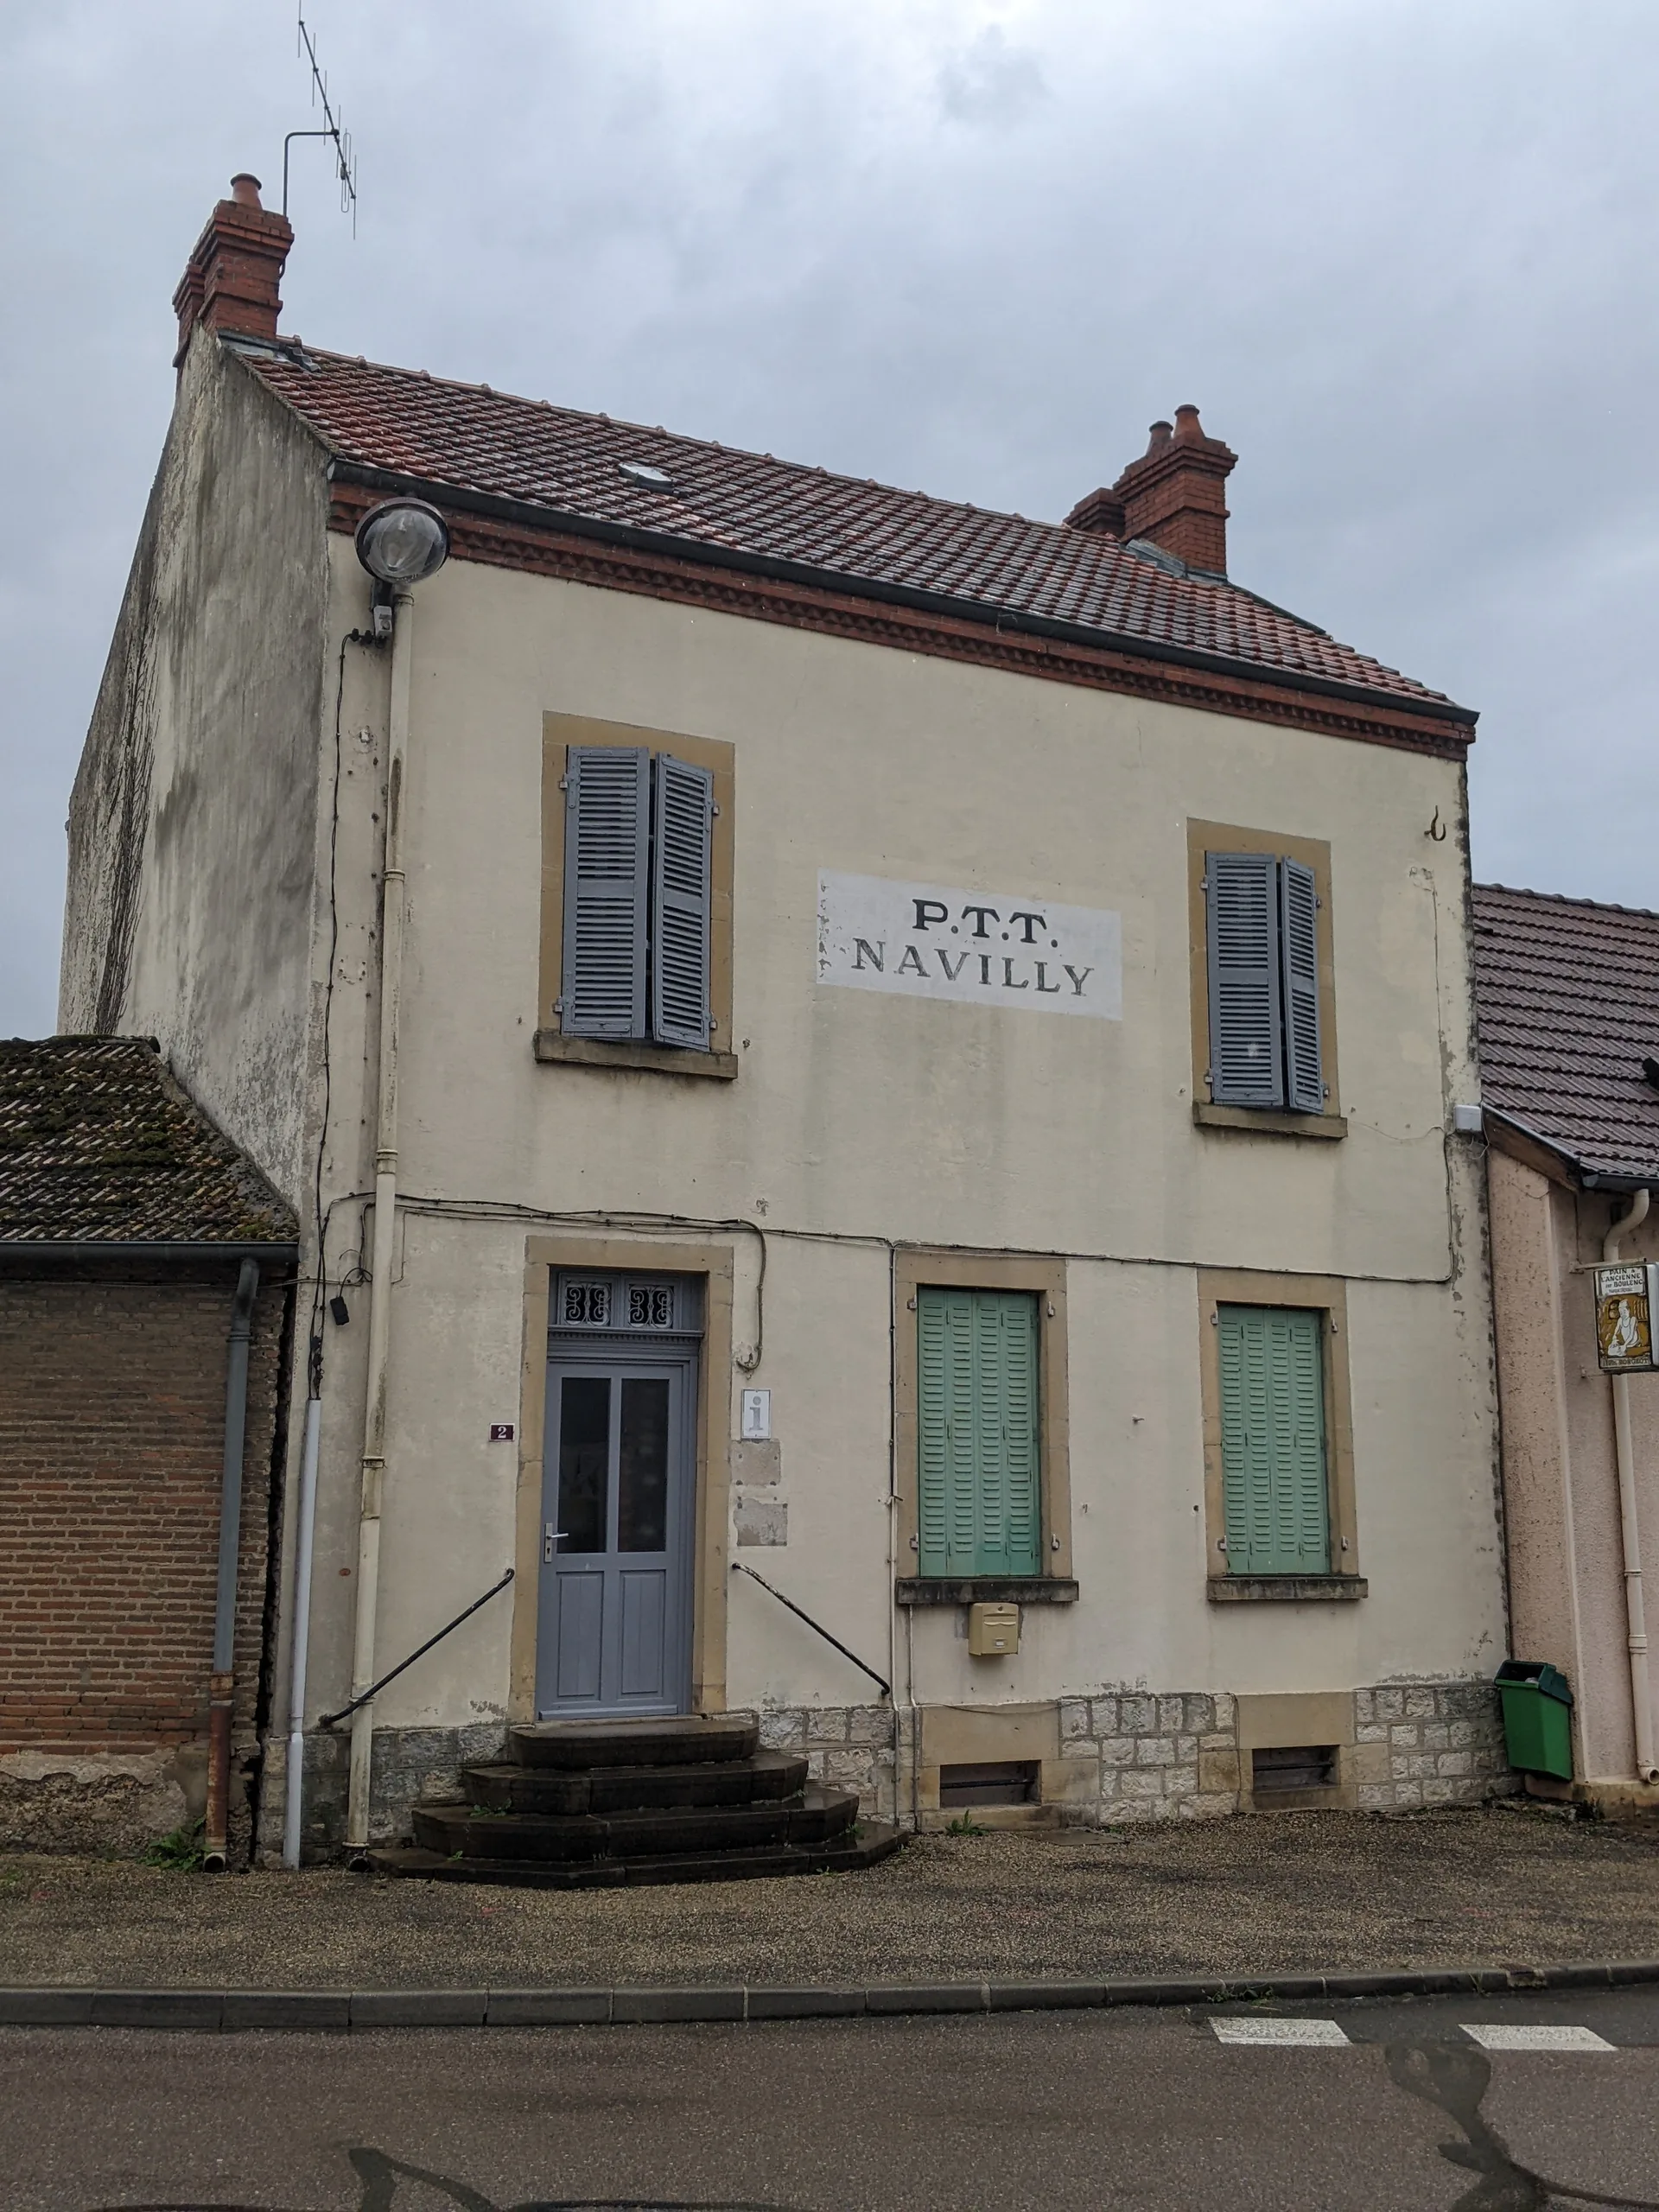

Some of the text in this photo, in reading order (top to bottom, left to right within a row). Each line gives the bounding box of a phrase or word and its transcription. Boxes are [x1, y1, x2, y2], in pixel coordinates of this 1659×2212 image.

[912, 899, 1058, 948] P.T.T.
[850, 938, 1095, 996] NAVILLY
[1600, 1272, 1641, 1282] L'ANCIENNE
[497, 1426, 507, 1439] 2
